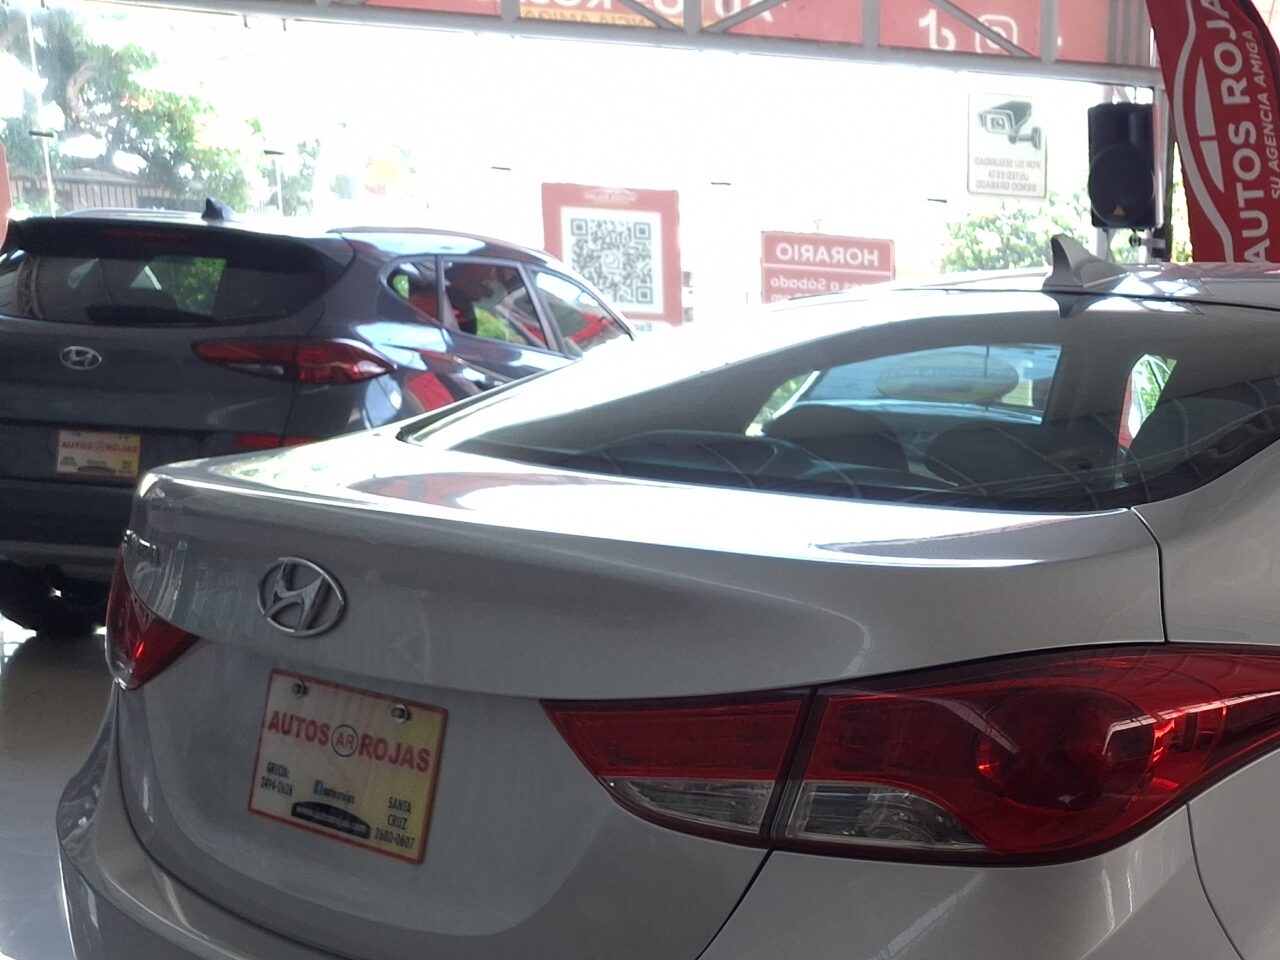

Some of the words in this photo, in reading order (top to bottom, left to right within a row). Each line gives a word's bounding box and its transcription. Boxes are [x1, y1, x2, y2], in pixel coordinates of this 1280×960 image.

[1241, 30, 1266, 86] AMIGA
[1256, 93, 1280, 173] AGENCIA
[1228, 121, 1272, 264] AUTOS
[267, 709, 331, 747] AUTOS
[334, 731, 355, 750] AR
[358, 733, 430, 773] ROJAS
